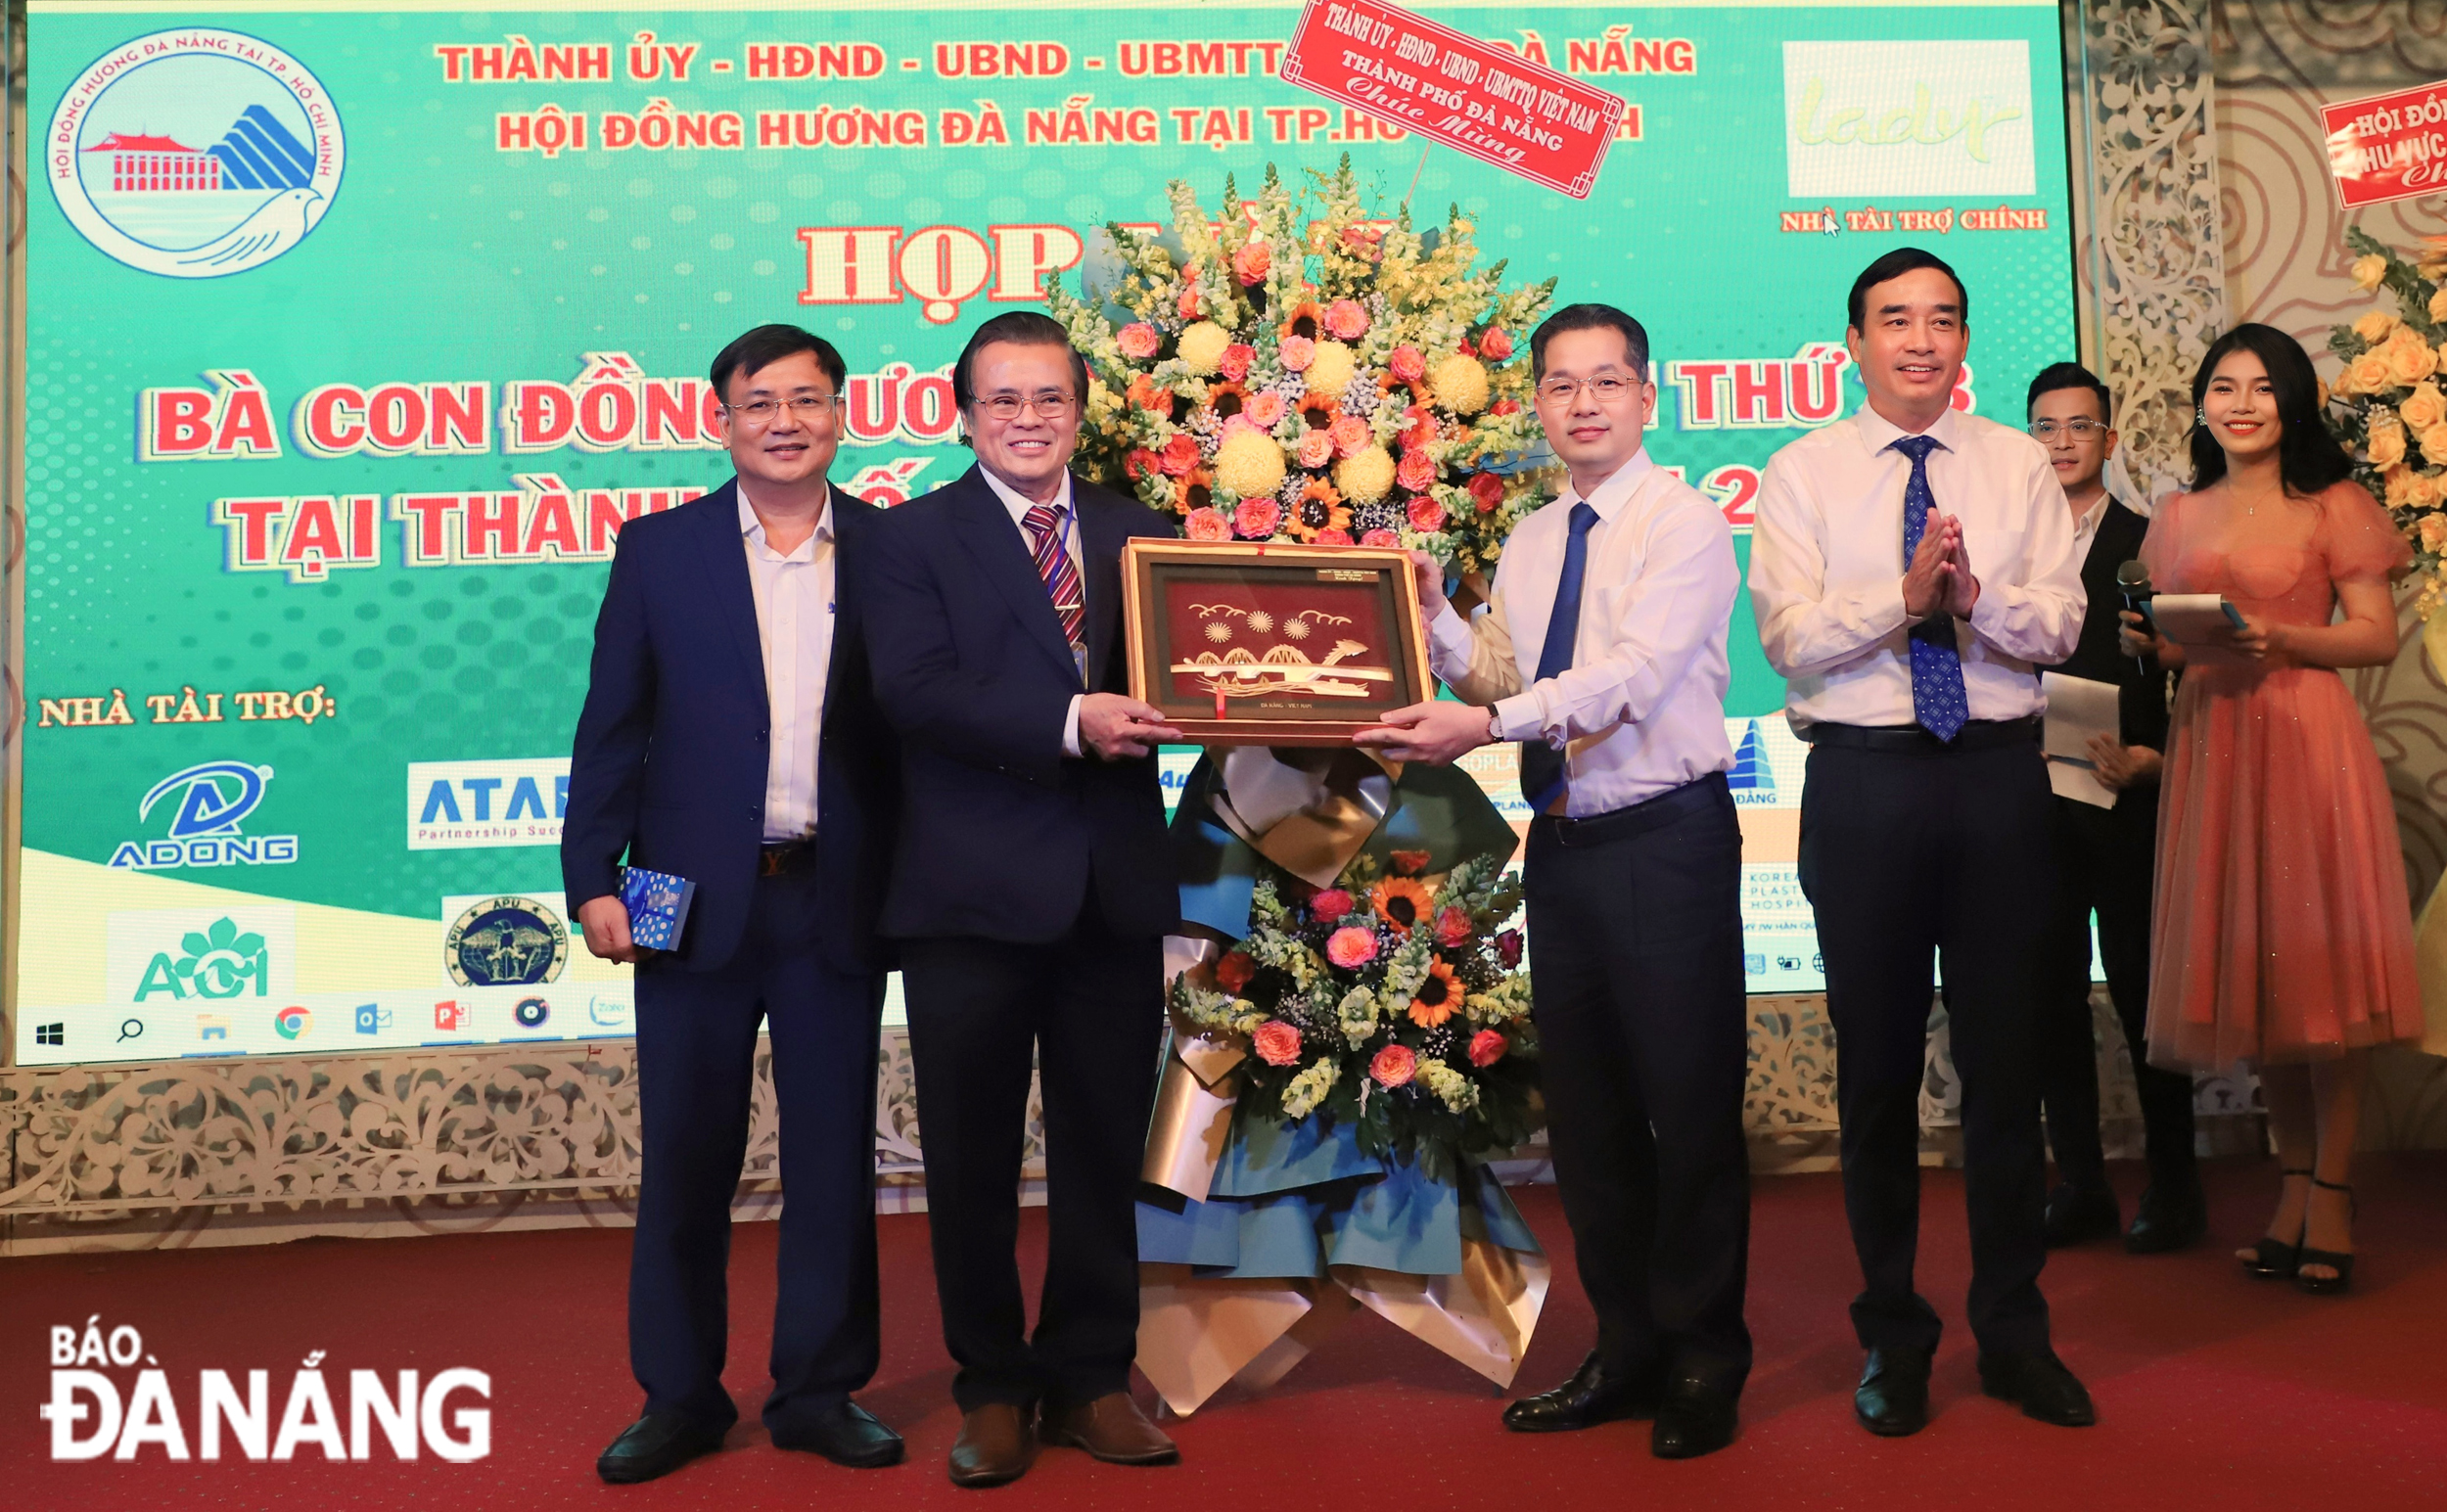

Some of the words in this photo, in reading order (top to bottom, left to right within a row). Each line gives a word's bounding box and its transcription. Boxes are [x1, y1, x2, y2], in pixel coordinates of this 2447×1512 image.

[437, 35, 611, 81] THÀNH
[628, 31, 698, 80] ỦY
[746, 43, 886, 78] HĐND
[935, 43, 1069, 76] UBND
[1119, 42, 1285, 75] UBMTT
[1568, 25, 1694, 73] NẴNG
[1342, 50, 1417, 93] THÀNH
[1418, 81, 1468, 112] PHỐ
[1465, 100, 1498, 127] ĐÀ
[1501, 115, 1563, 153] NẴNG
[1395, 32, 1437, 68] HĐND
[1441, 50, 1481, 85] UBND
[1484, 68, 1538, 115] UBMTTQ
[1537, 88, 1569, 124] VIỆT
[1565, 101, 1600, 134] NAM
[497, 105, 586, 156] HỘI
[601, 99, 743, 149] ĐỒNG
[758, 106, 926, 147] HƯƠNG
[940, 101, 1008, 145] ĐÀ
[1027, 95, 1158, 143] NẴNG
[1171, 108, 1251, 149] TẠI
[1346, 76, 1425, 120] Chúc
[1428, 115, 1526, 163] Mừng
[2355, 106, 2403, 138] HỘI
[317, 133, 333, 177] MINH
[1846, 206, 1894, 232] TÀI
[1897, 206, 1955, 235] TRỢ
[1960, 204, 2049, 231] CHÍNH
[797, 224, 1085, 324] HỌP
[1672, 344, 1852, 427] THỨ
[149, 368, 282, 457] BÀ
[299, 382, 489, 455] CON
[220, 491, 381, 580] TẠI
[38, 687, 135, 728] NHÀ
[146, 685, 224, 723] TÀI
[234, 684, 336, 725] TRỢ:
[109, 836, 298, 869] ADONG
[418, 826, 519, 841] Partnership
[492, 898, 521, 910] APU
[1750, 885, 1797, 896] PLAST
[1751, 899, 1809, 910] HOSPIT
[448, 925, 465, 950] APU
[548, 922, 565, 946] APU
